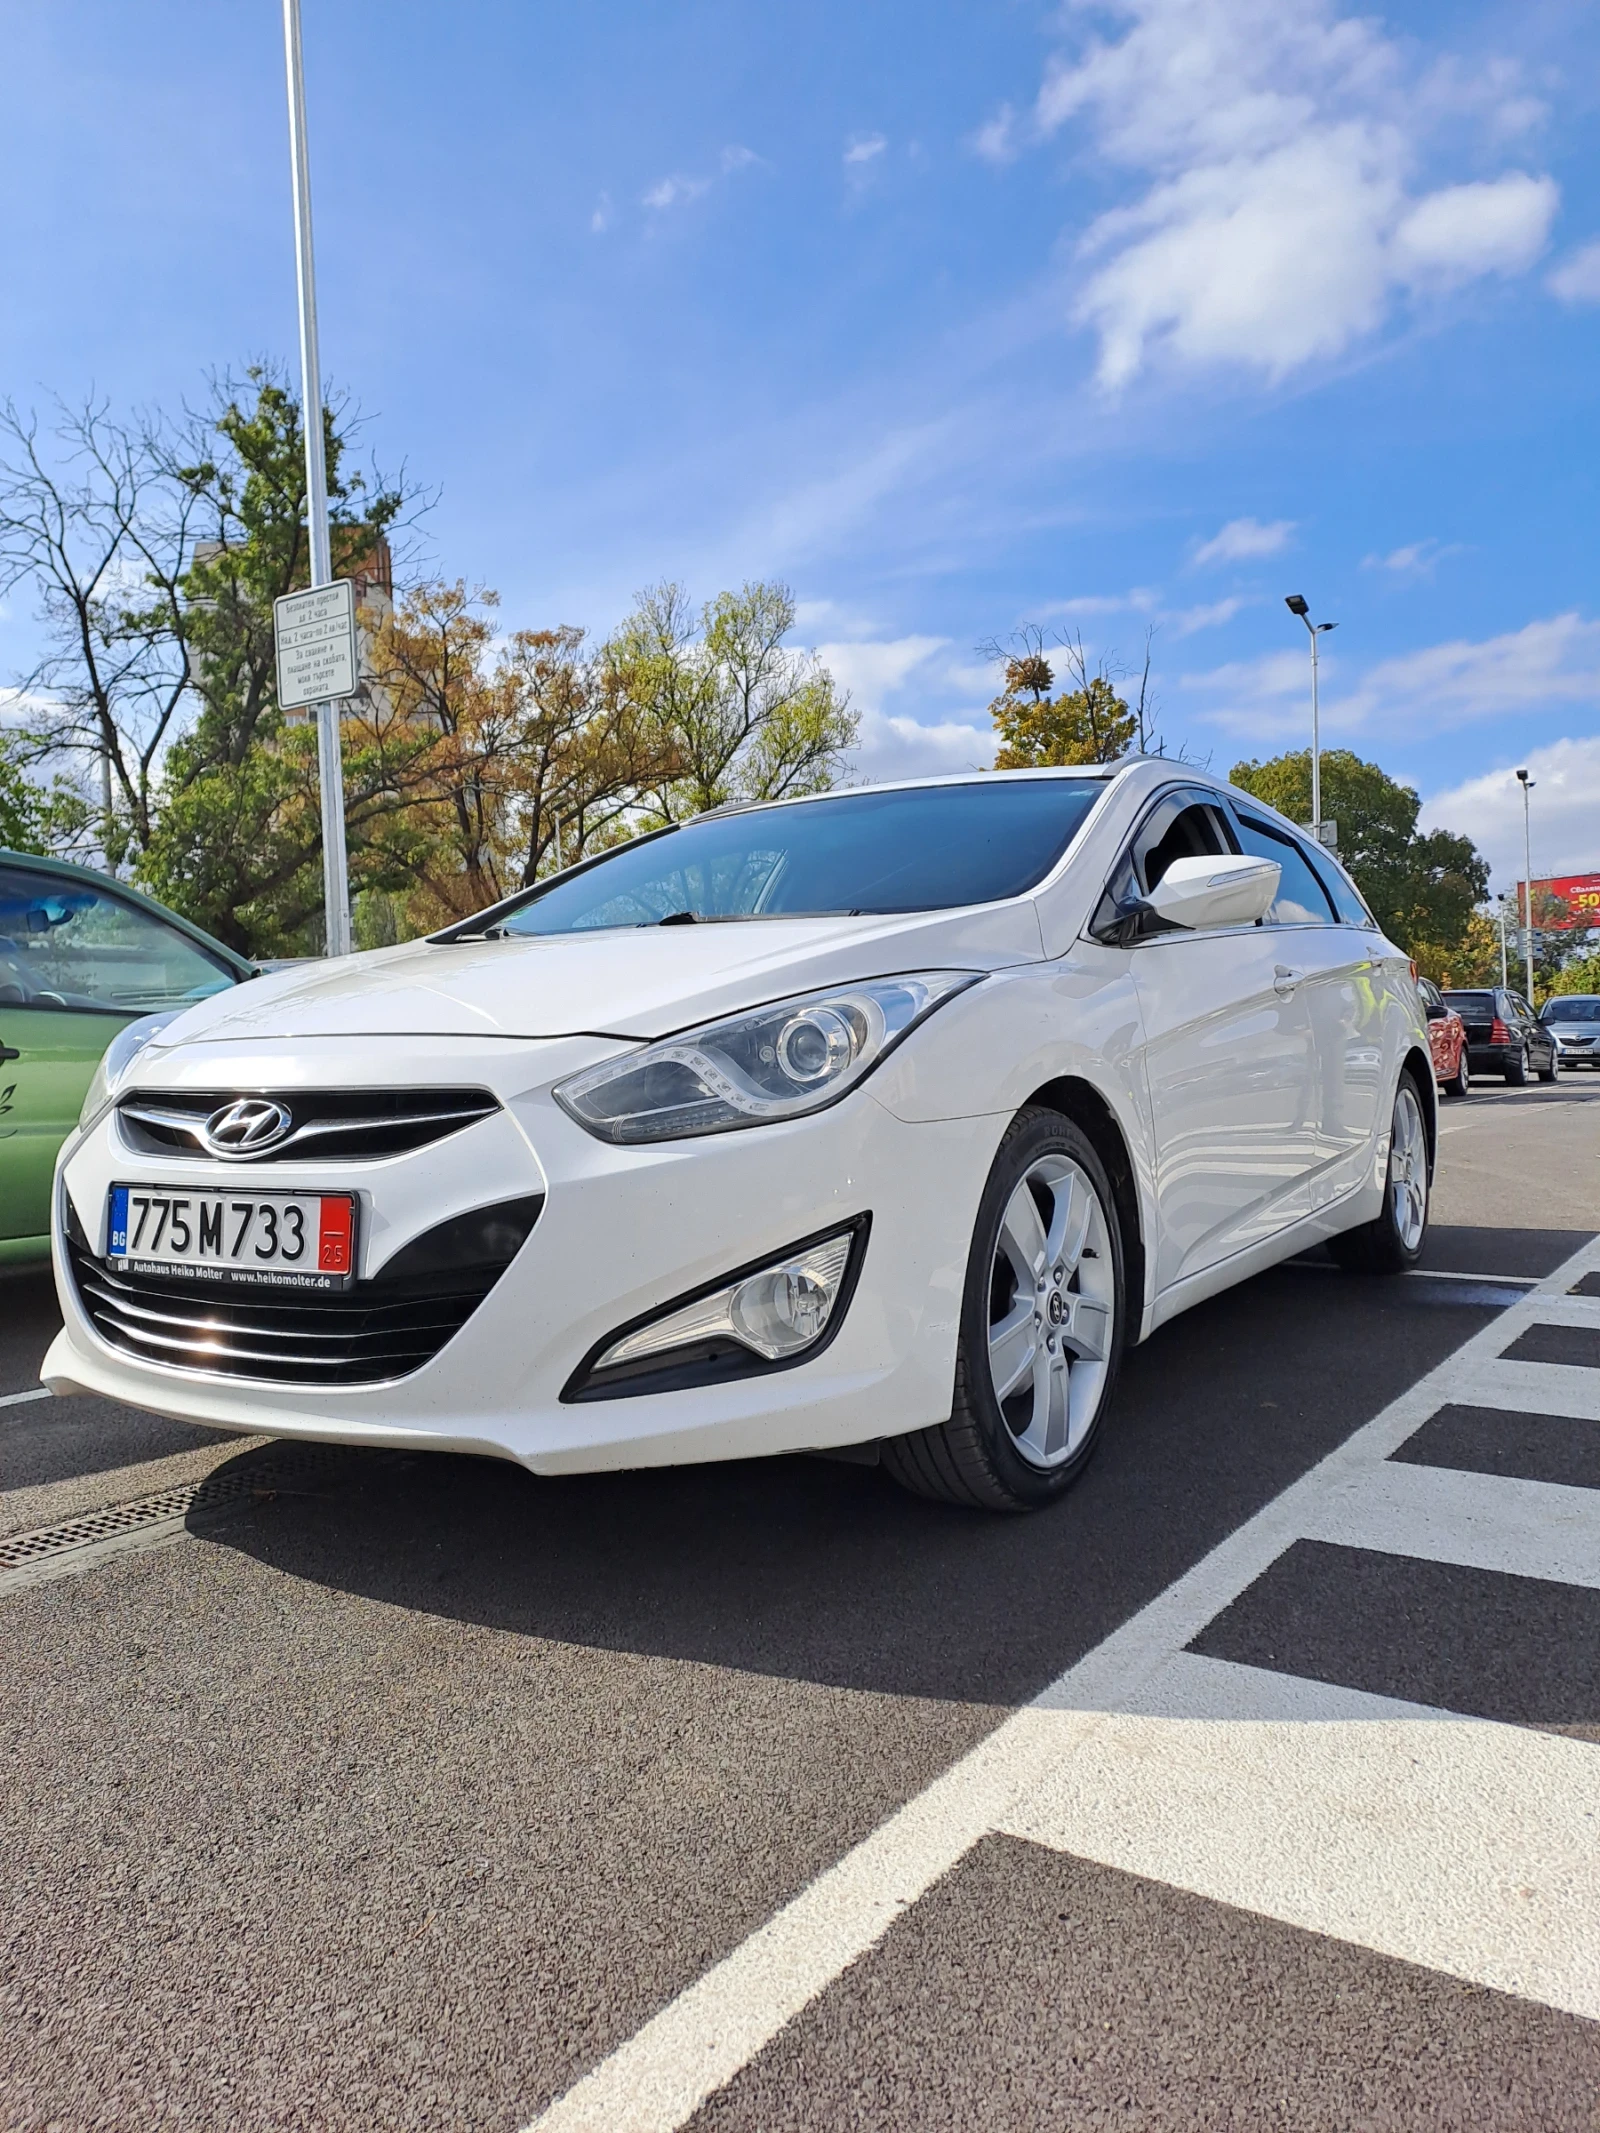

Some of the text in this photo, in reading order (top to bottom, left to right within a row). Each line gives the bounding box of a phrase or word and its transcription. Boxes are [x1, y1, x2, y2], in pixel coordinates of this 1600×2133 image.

[286, 592, 339, 613] Безплатен престой
[299, 608, 327, 623] до 2 часа
[281, 635, 292, 645] Над
[294, 632, 298, 642] 2
[324, 624, 328, 634] 2
[296, 649, 303, 660] За
[305, 645, 327, 657] сваляне
[287, 661, 311, 674] плащане
[298, 669, 334, 684] моля търсете
[1571, 893, 1600, 907] -50
[112, 1230, 126, 1247] BG
[323, 1244, 343, 1264] 25
[133, 1261, 331, 1288] Autohaus Heiko Molter www.heikomolter.de
